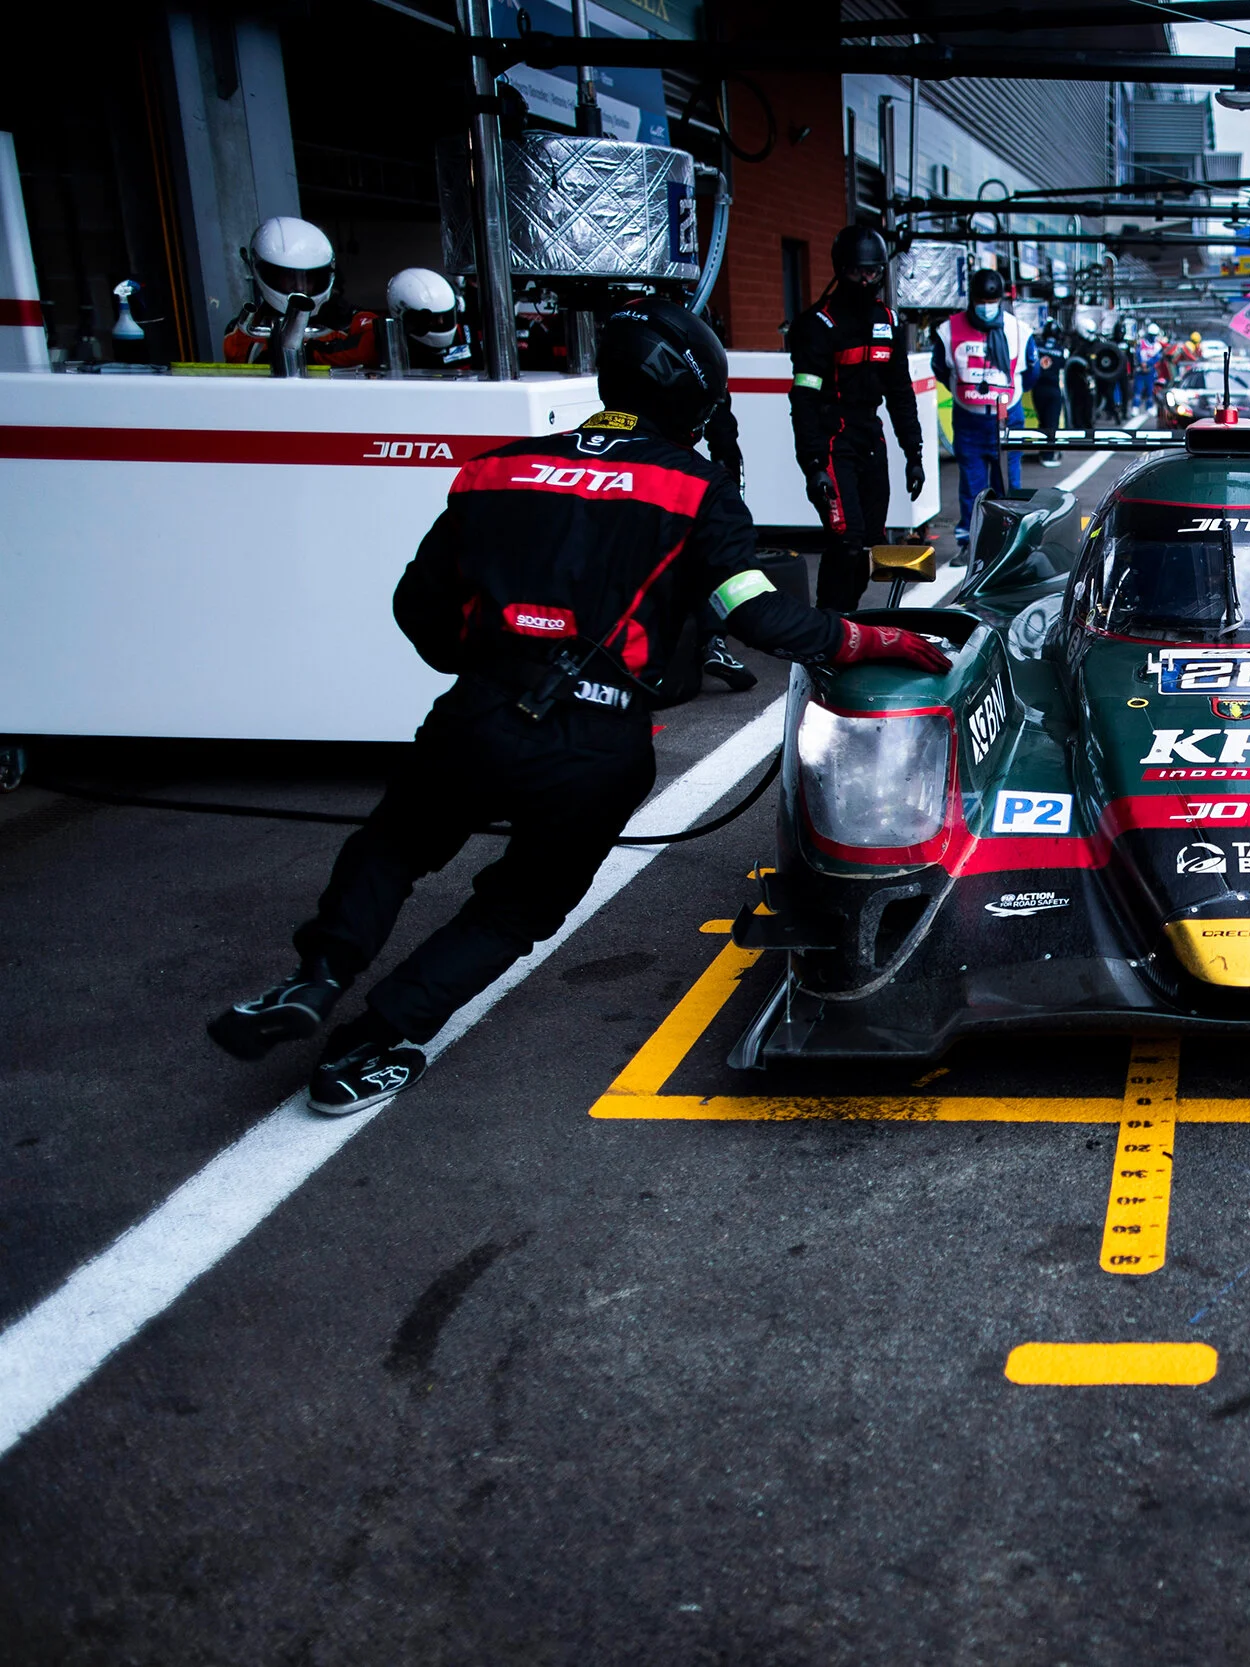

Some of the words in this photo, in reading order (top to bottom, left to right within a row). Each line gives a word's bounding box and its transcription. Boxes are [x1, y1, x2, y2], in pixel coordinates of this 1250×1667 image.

[679, 199, 698, 253] 2
[363, 441, 453, 460] JOTA
[511, 463, 633, 491] JOTA
[516, 614, 566, 630] sparco
[984, 672, 1007, 745] BNI
[1002, 797, 1064, 826] P2
[1016, 892, 1055, 901] ACTION
[1013, 900, 1036, 908] ROAD
[1037, 898, 1070, 906] SAFETY
[1137, 1098, 1151, 1106] 0
[1127, 1120, 1154, 1129] 10
[1124, 1144, 1152, 1153] 20
[1120, 1169, 1148, 1179] 30
[1116, 1196, 1147, 1205] 40
[1112, 1225, 1142, 1234] 50
[1109, 1255, 1142, 1265] 60
